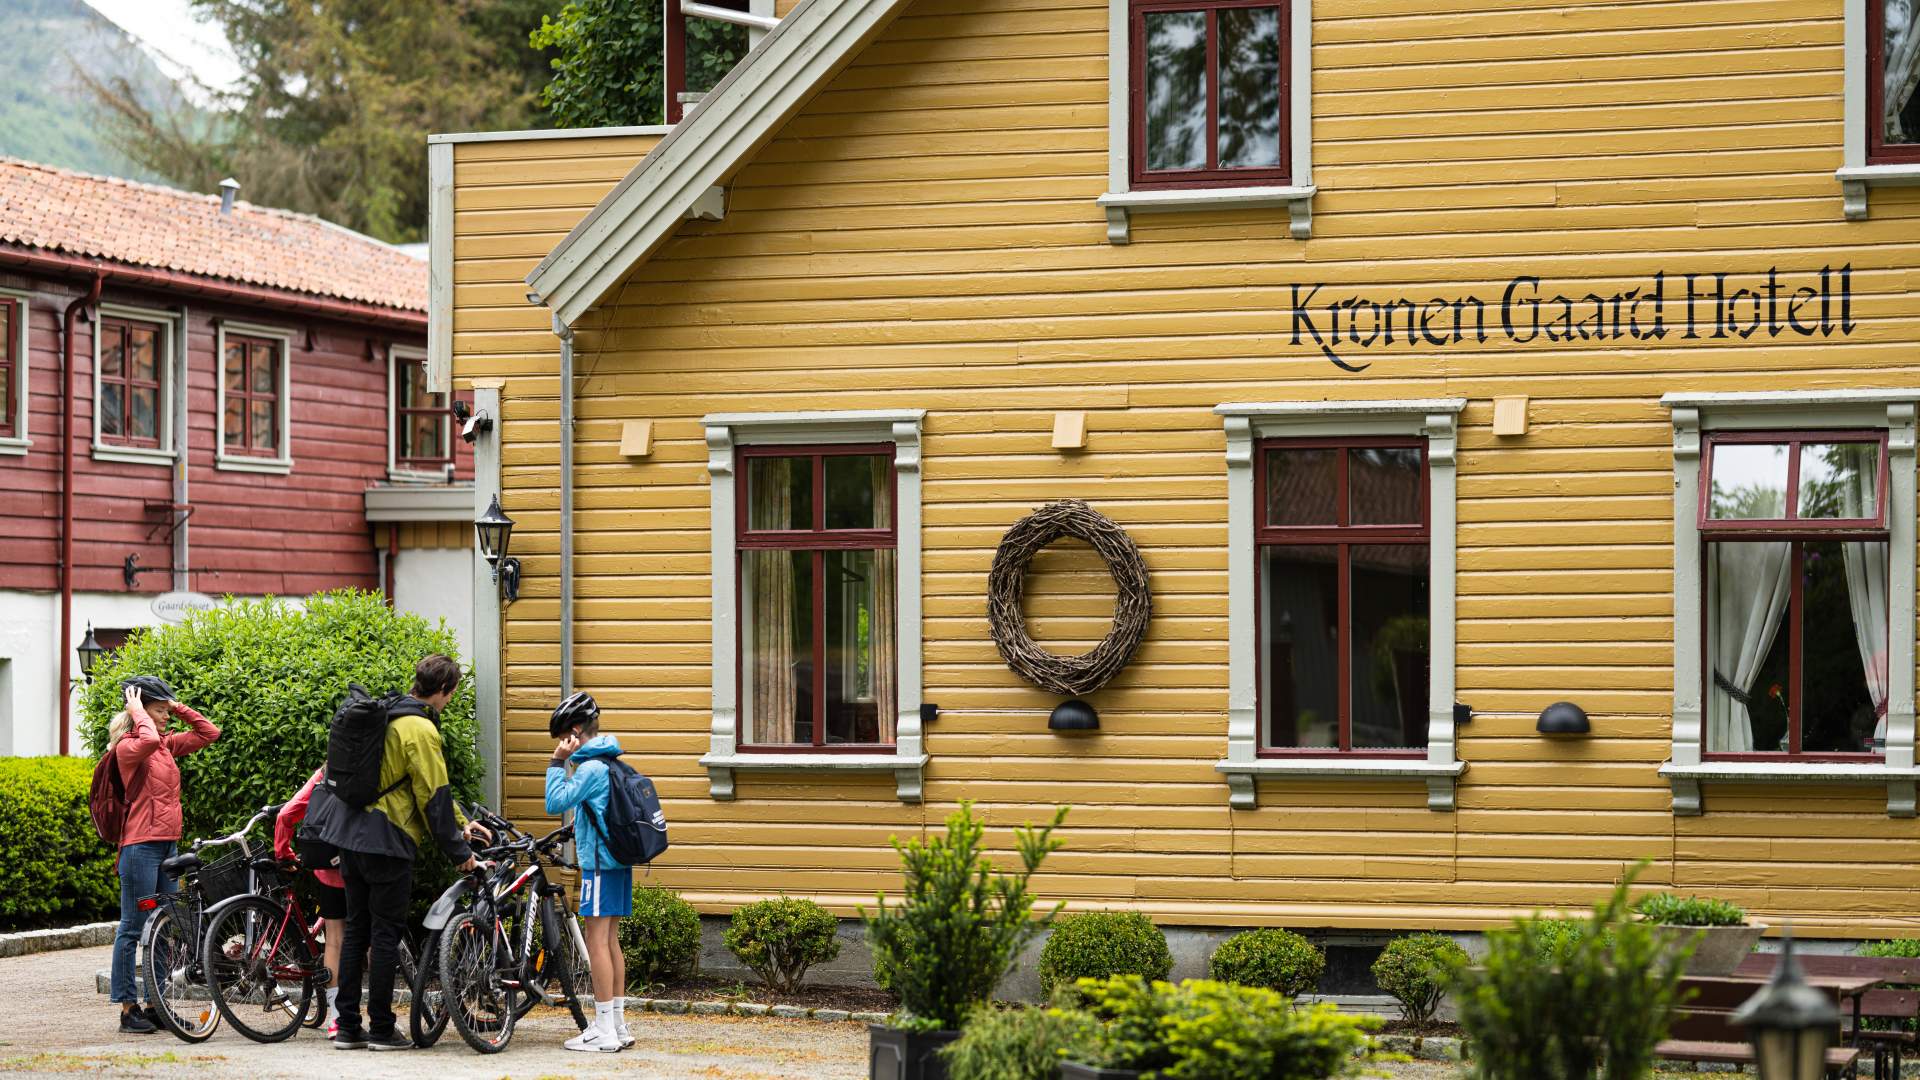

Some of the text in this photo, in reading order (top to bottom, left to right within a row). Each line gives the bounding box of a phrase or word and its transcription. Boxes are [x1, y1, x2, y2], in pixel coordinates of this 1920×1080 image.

[1288, 262, 1857, 372] Kronen Gaard Hotell
